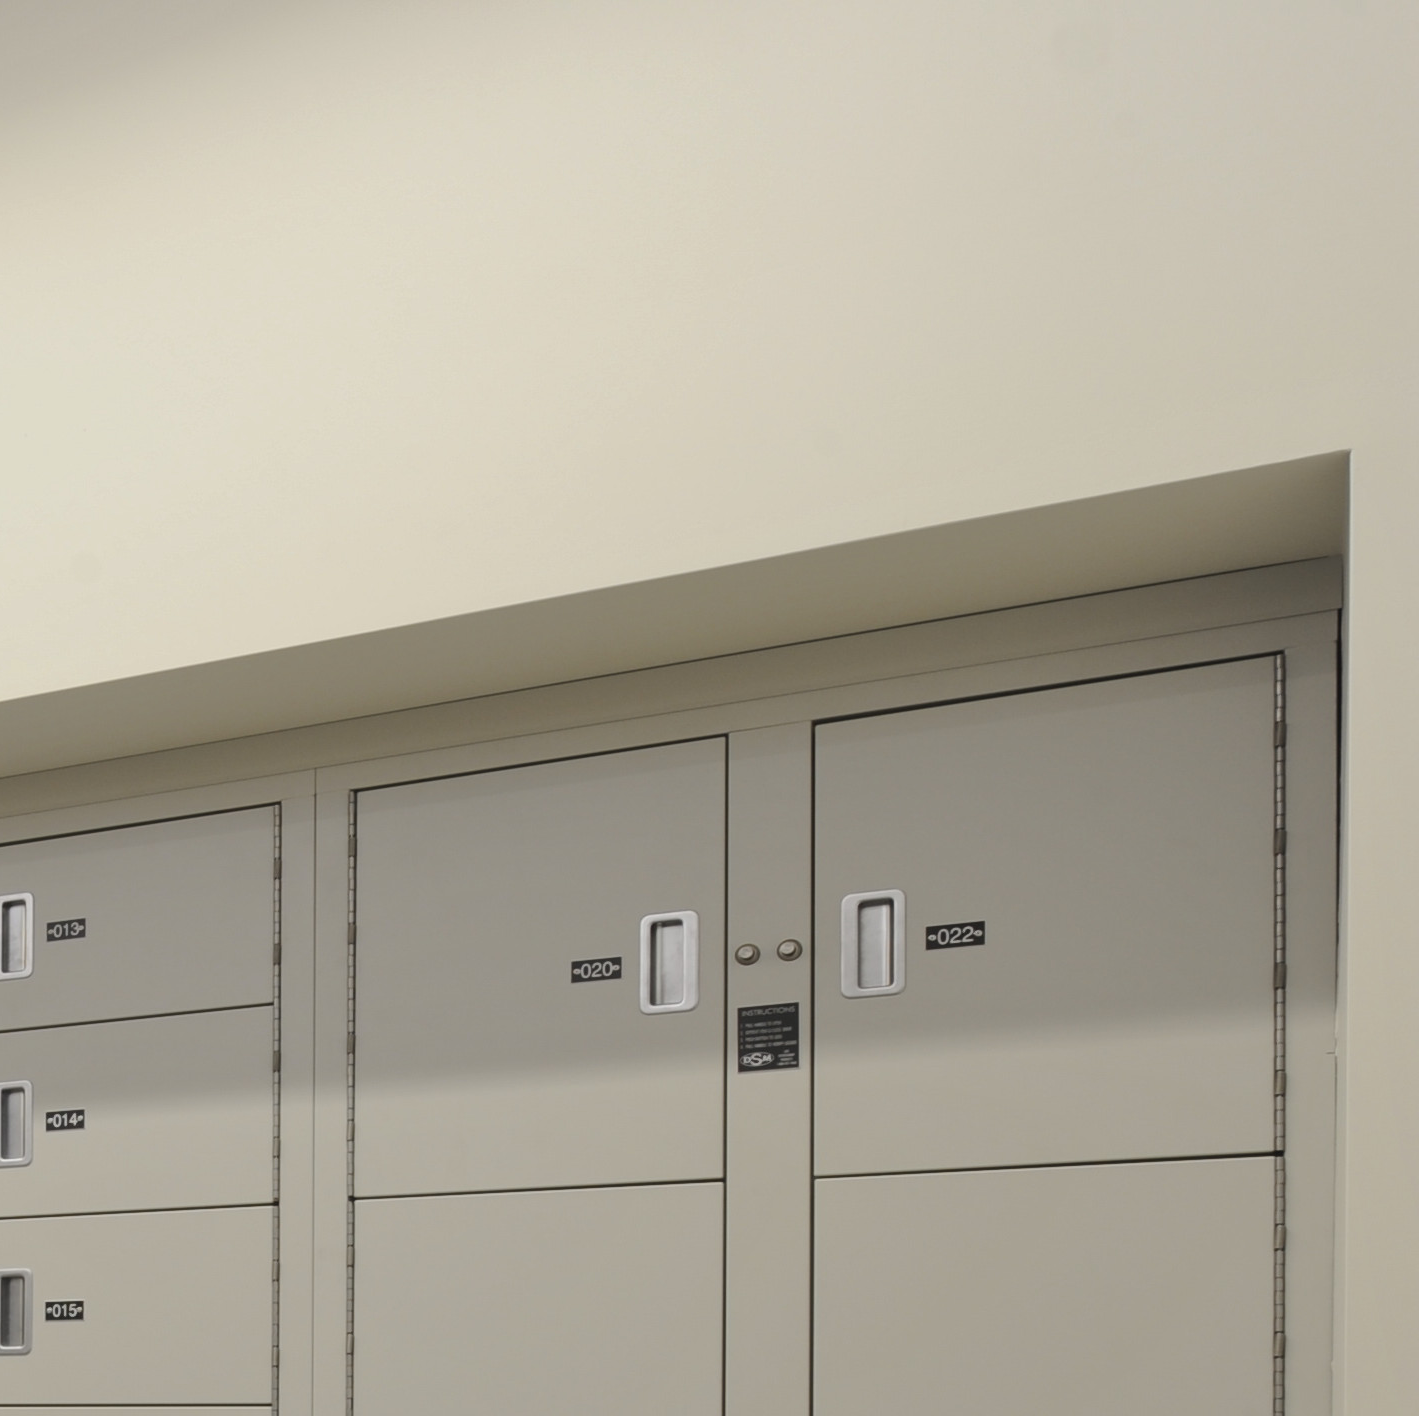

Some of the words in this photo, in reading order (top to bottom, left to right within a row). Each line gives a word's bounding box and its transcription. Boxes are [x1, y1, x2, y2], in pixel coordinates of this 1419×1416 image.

[53, 922, 80, 938] 013
[937, 926, 974, 945] 022
[580, 961, 614, 979] 020
[53, 1112, 78, 1128] 014
[53, 1303, 77, 1317] 015
